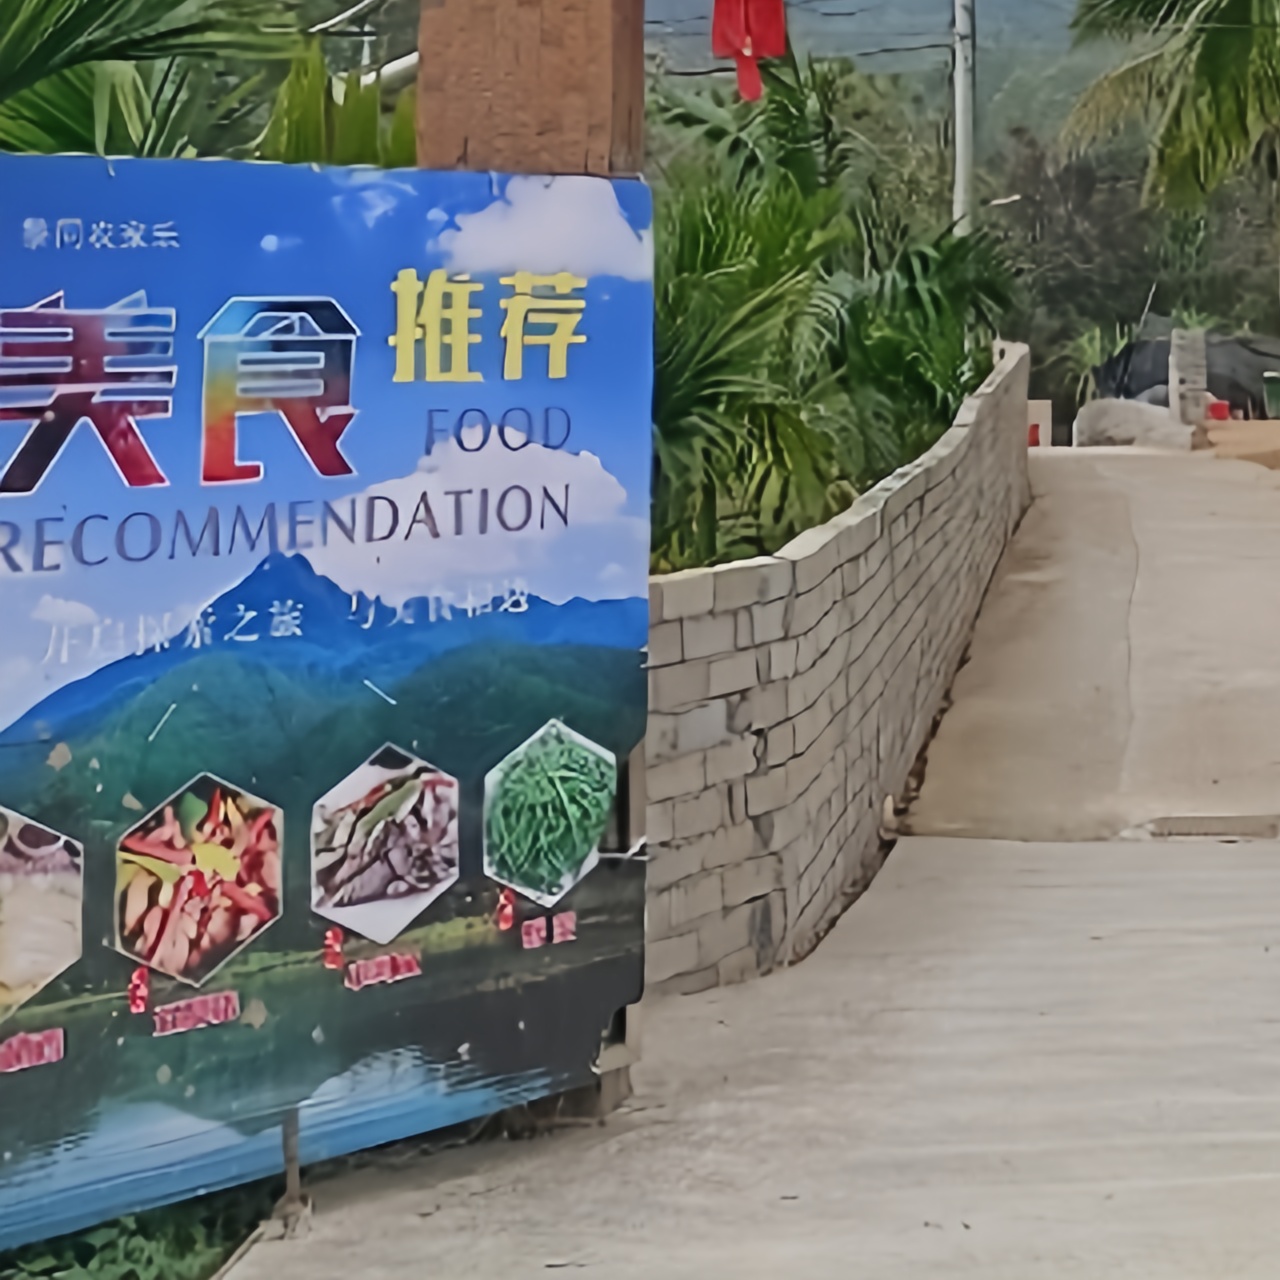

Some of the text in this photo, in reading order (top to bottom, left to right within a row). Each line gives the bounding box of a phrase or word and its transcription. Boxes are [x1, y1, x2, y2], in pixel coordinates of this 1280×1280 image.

[0, 268, 588, 496] 美食 推荐
[425, 407, 572, 457] FOOD
